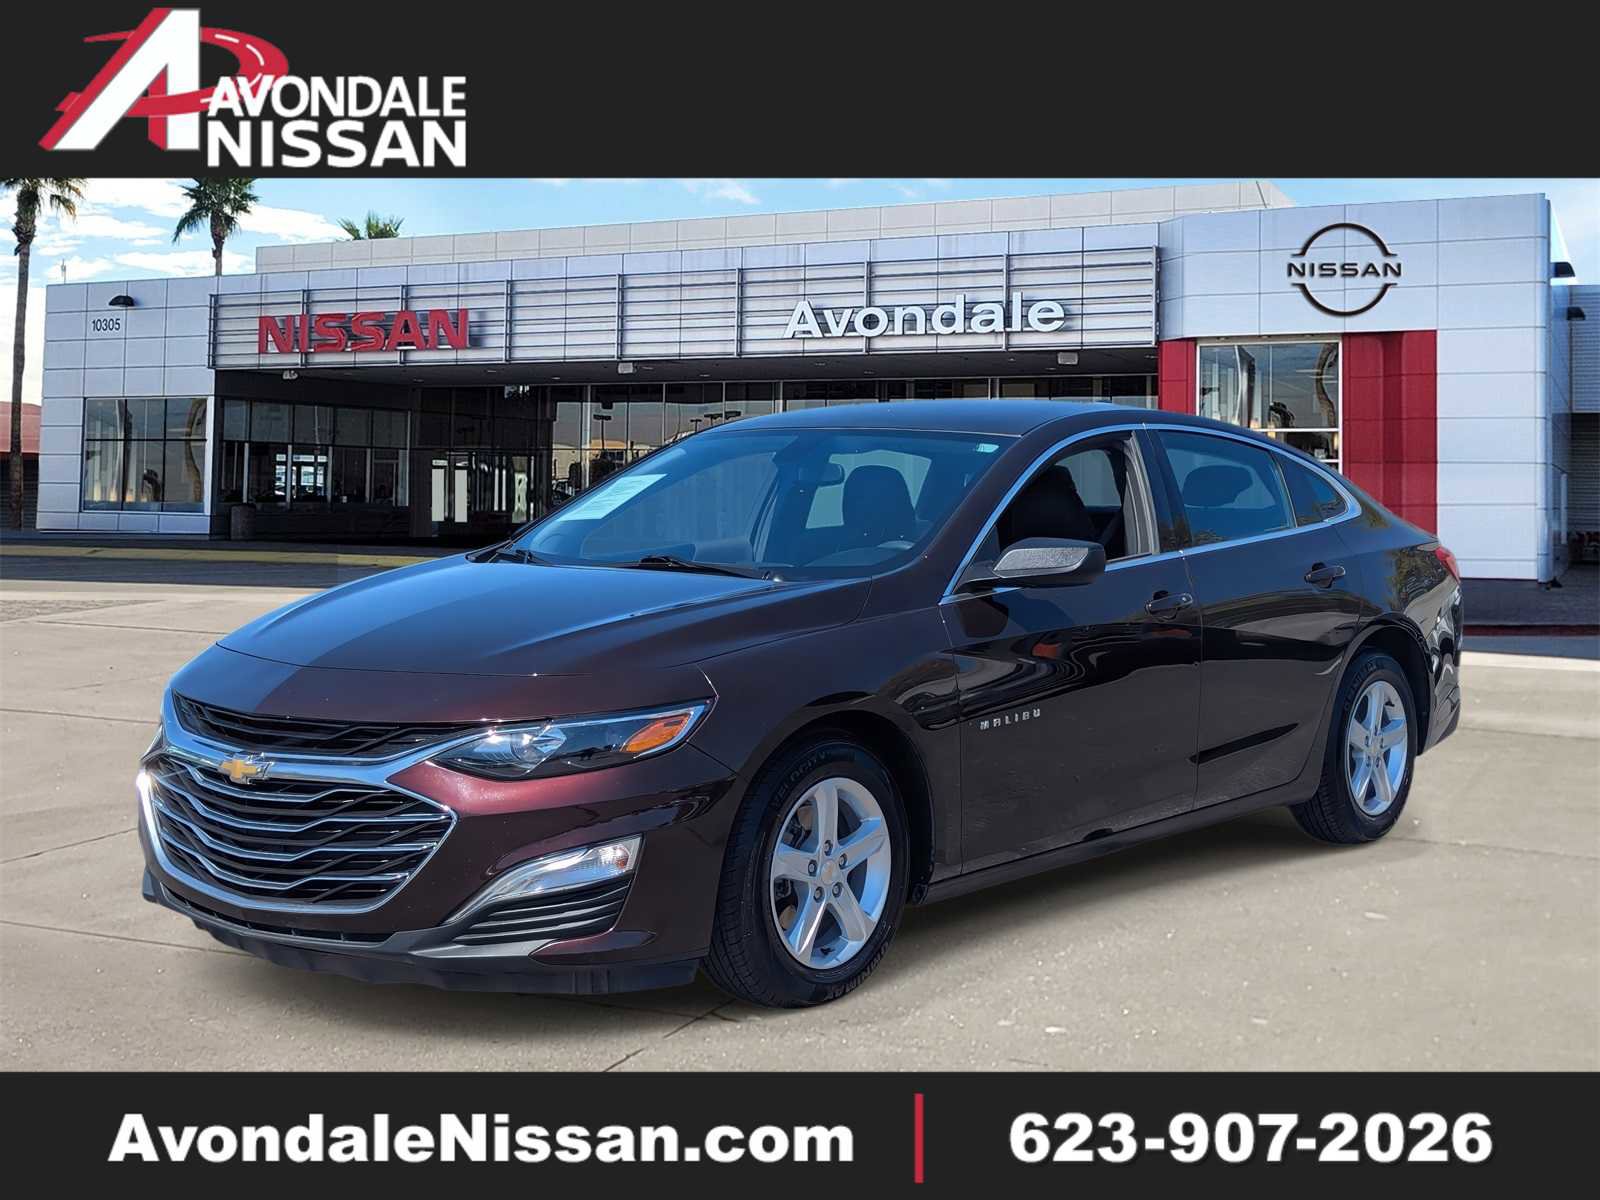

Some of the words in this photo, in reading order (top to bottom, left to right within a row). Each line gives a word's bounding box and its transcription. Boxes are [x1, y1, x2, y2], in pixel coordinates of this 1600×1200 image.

[1287, 262, 1403, 278] NISSAN
[92, 318, 121, 332] 10305
[784, 291, 1065, 338] Avondale
[258, 309, 469, 353] NISSAN
[980, 708, 1041, 731] MALIBU
